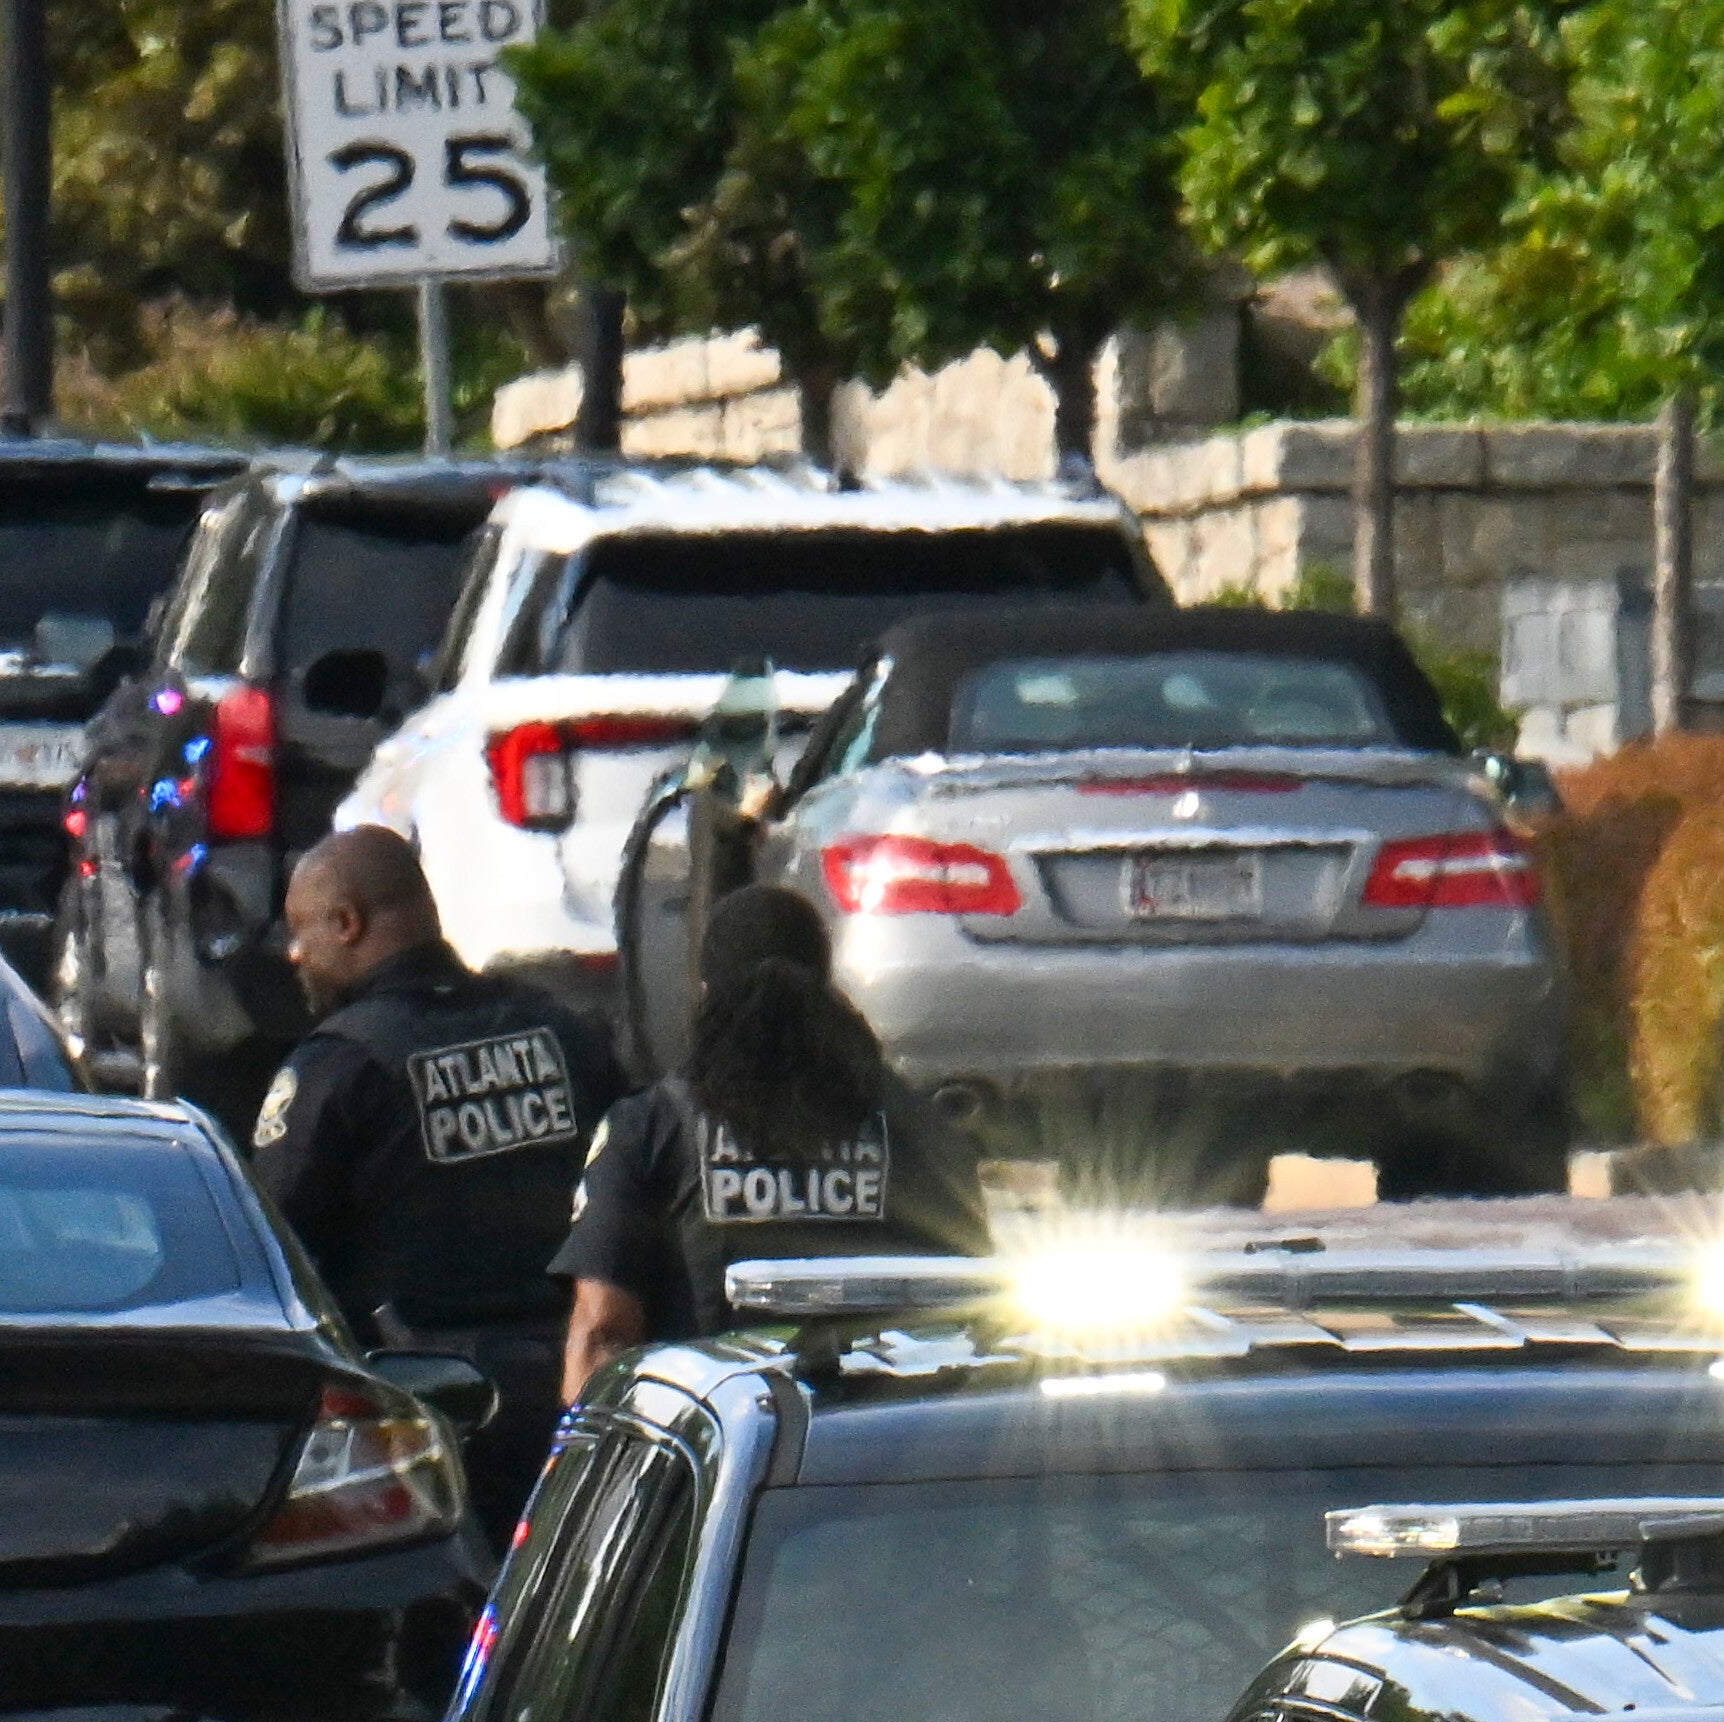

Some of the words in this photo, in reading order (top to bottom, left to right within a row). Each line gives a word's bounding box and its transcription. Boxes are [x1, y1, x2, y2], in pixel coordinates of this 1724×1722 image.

[310, 2, 518, 50] SPEED
[335, 62, 489, 115] LIMIT
[326, 138, 532, 250] 25
[425, 1036, 563, 1104] ATLANTA
[429, 1088, 572, 1156] POLICE
[711, 1169, 881, 1216] POLICE
